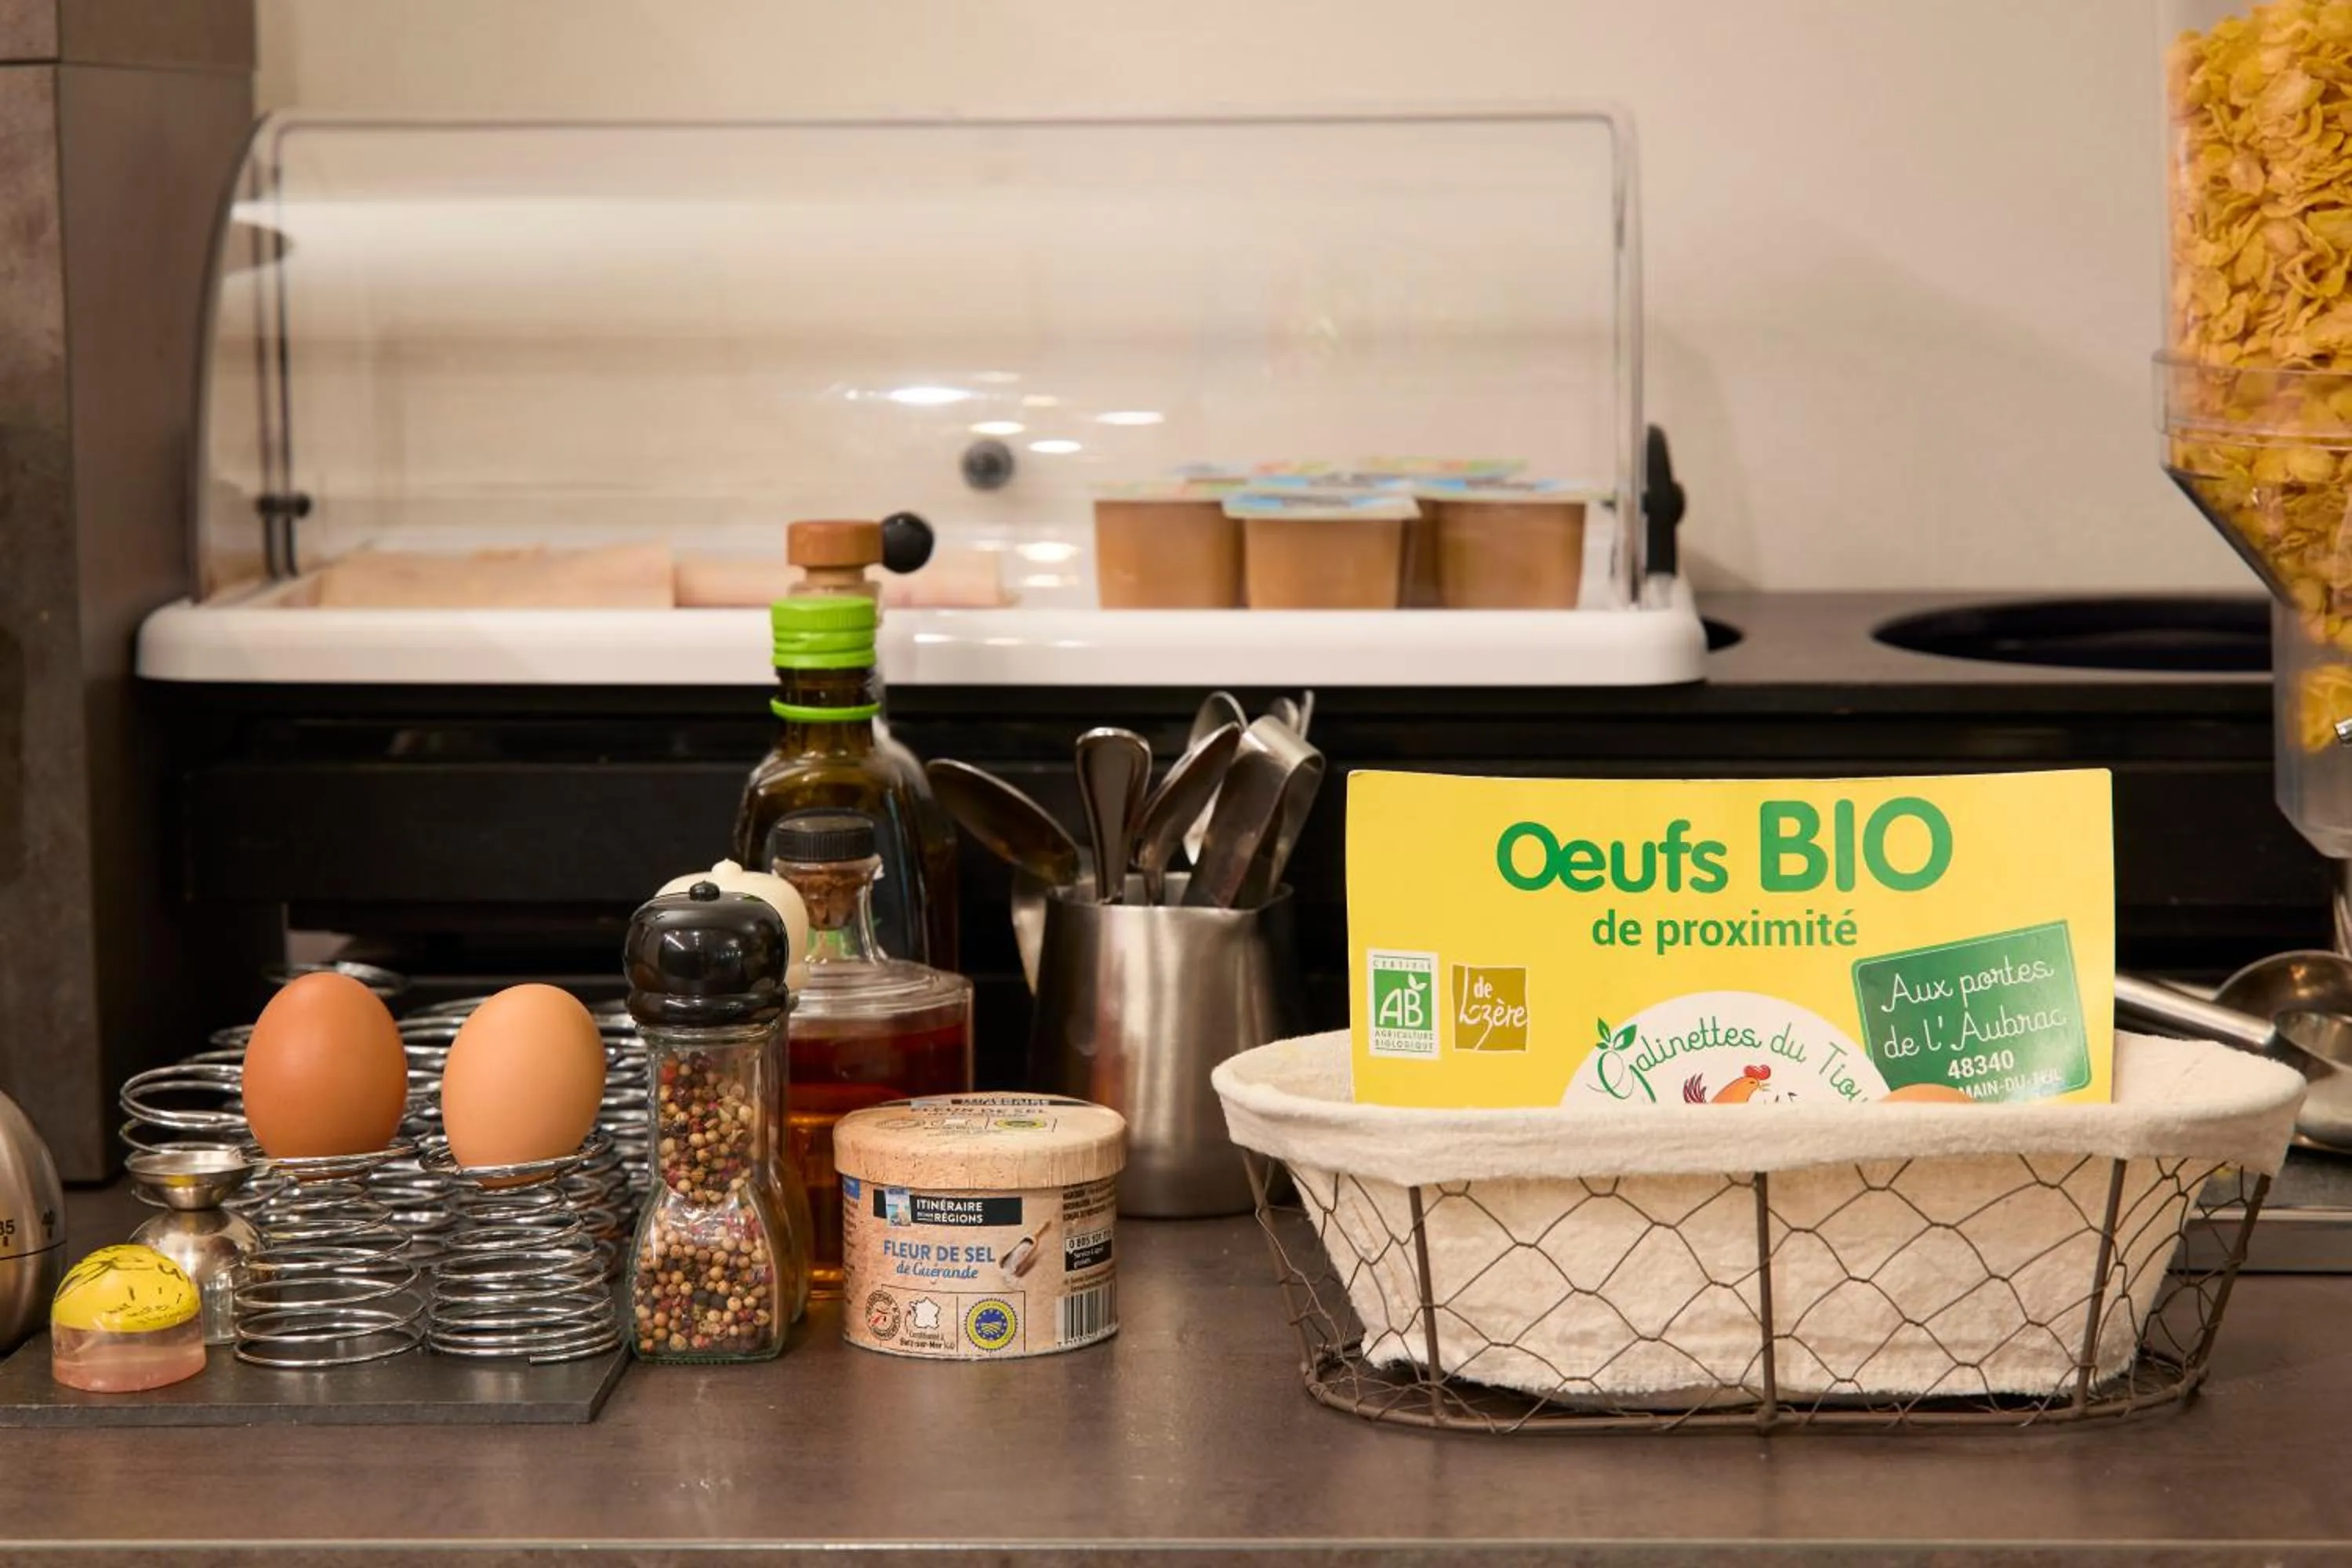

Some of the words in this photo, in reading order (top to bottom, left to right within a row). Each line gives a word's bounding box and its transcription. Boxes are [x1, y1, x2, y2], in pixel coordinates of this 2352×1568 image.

[1497, 819, 1729, 893] Oeufs
[1759, 797, 1953, 892] BIO
[1592, 909, 1642, 946] de
[1657, 909, 1858, 955] proximité
[1473, 975, 1494, 998] de
[1881, 973, 1954, 1013] Aux
[1959, 955, 2055, 1008] portes
[1379, 988, 1424, 1027] AB
[1374, 1030, 1434, 1041] AGRICULTURE
[1374, 1039, 1434, 1051] BIOLOGIQUE
[1770, 1022, 1807, 1063] du
[1883, 1024, 1920, 1059] de
[1947, 1048, 2015, 1080] 48340
[916, 1199, 983, 1211] ITINÉRAIRE
[934, 1212, 984, 1224] RÉGIONS
[884, 1240, 931, 1260] FLEUR
[936, 1245, 960, 1263] DE
[965, 1246, 996, 1264] SEL
[896, 1260, 911, 1275] de
[912, 1261, 979, 1279] Guérande
